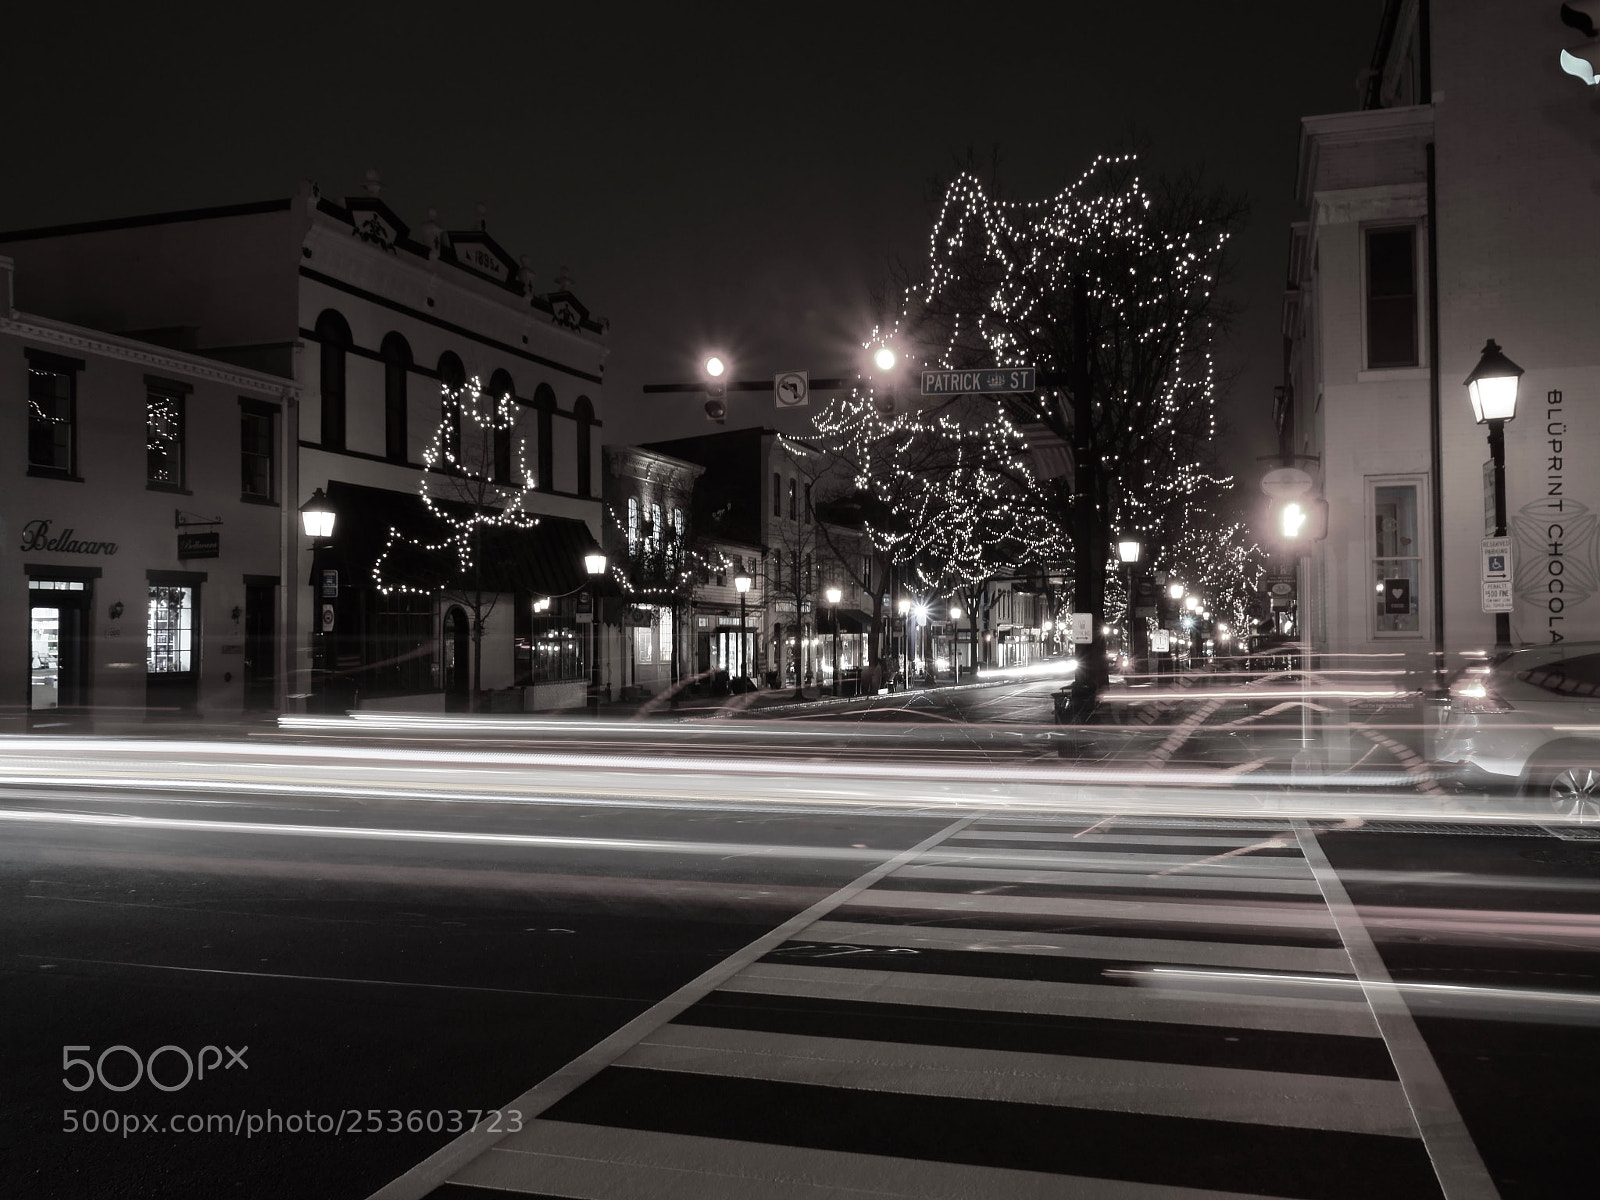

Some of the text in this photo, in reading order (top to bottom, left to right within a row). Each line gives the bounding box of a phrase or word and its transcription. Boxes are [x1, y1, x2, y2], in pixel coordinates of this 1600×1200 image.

[475, 249, 495, 270] 1895
[926, 371, 1029, 392] PATRICK ST
[1547, 388, 1567, 513] BLÜPRINT
[20, 519, 119, 555] Bellacara
[1499, 589, 1510, 597] FINE
